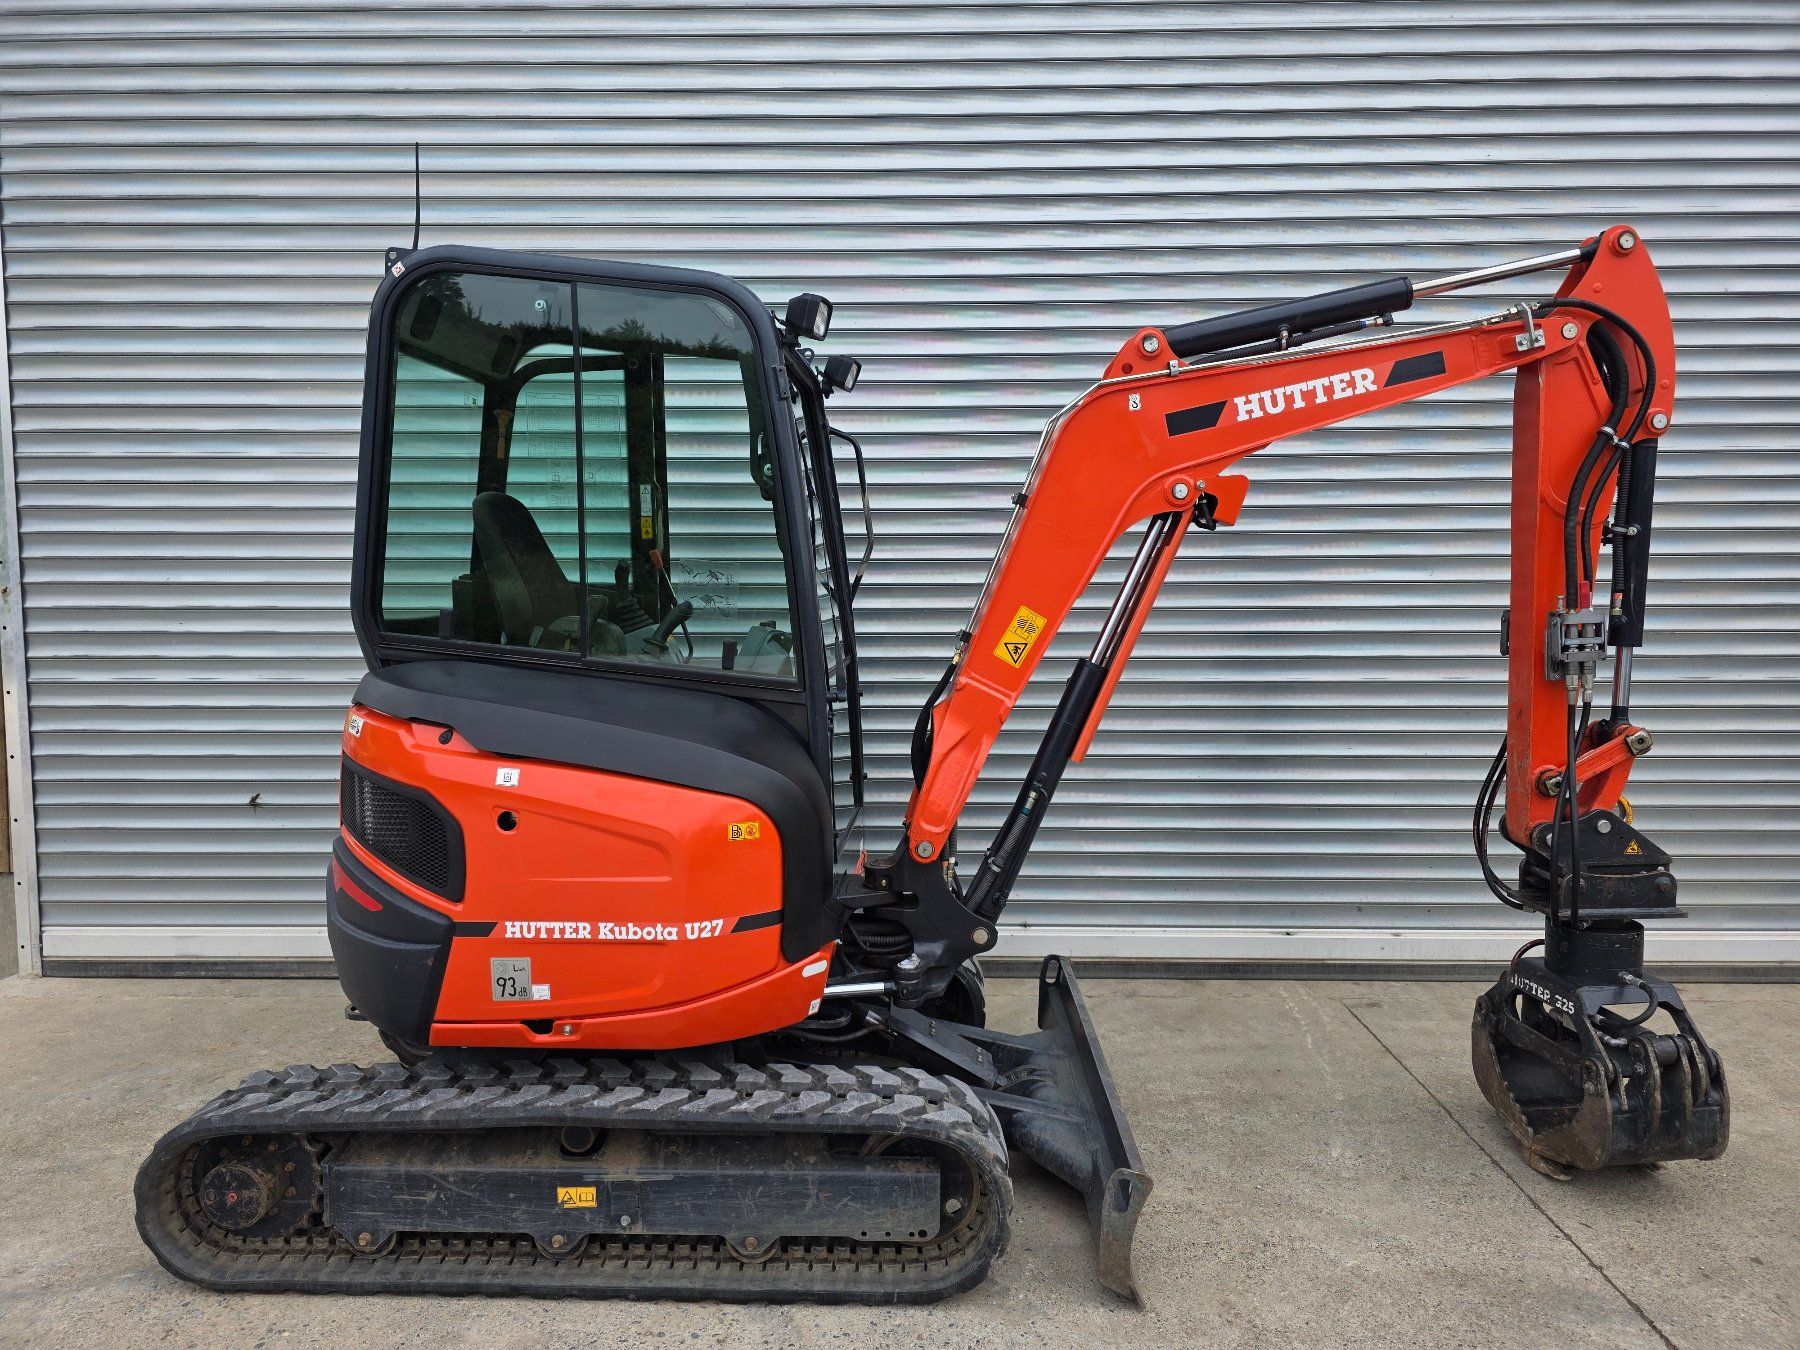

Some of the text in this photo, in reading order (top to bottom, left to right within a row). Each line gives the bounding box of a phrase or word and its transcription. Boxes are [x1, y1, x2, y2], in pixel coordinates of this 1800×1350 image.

[1233, 367, 1378, 422] HUTTER
[504, 919, 724, 940] HUTTER Kubota U27
[496, 976, 518, 998] 93
[518, 986, 528, 997] dB
